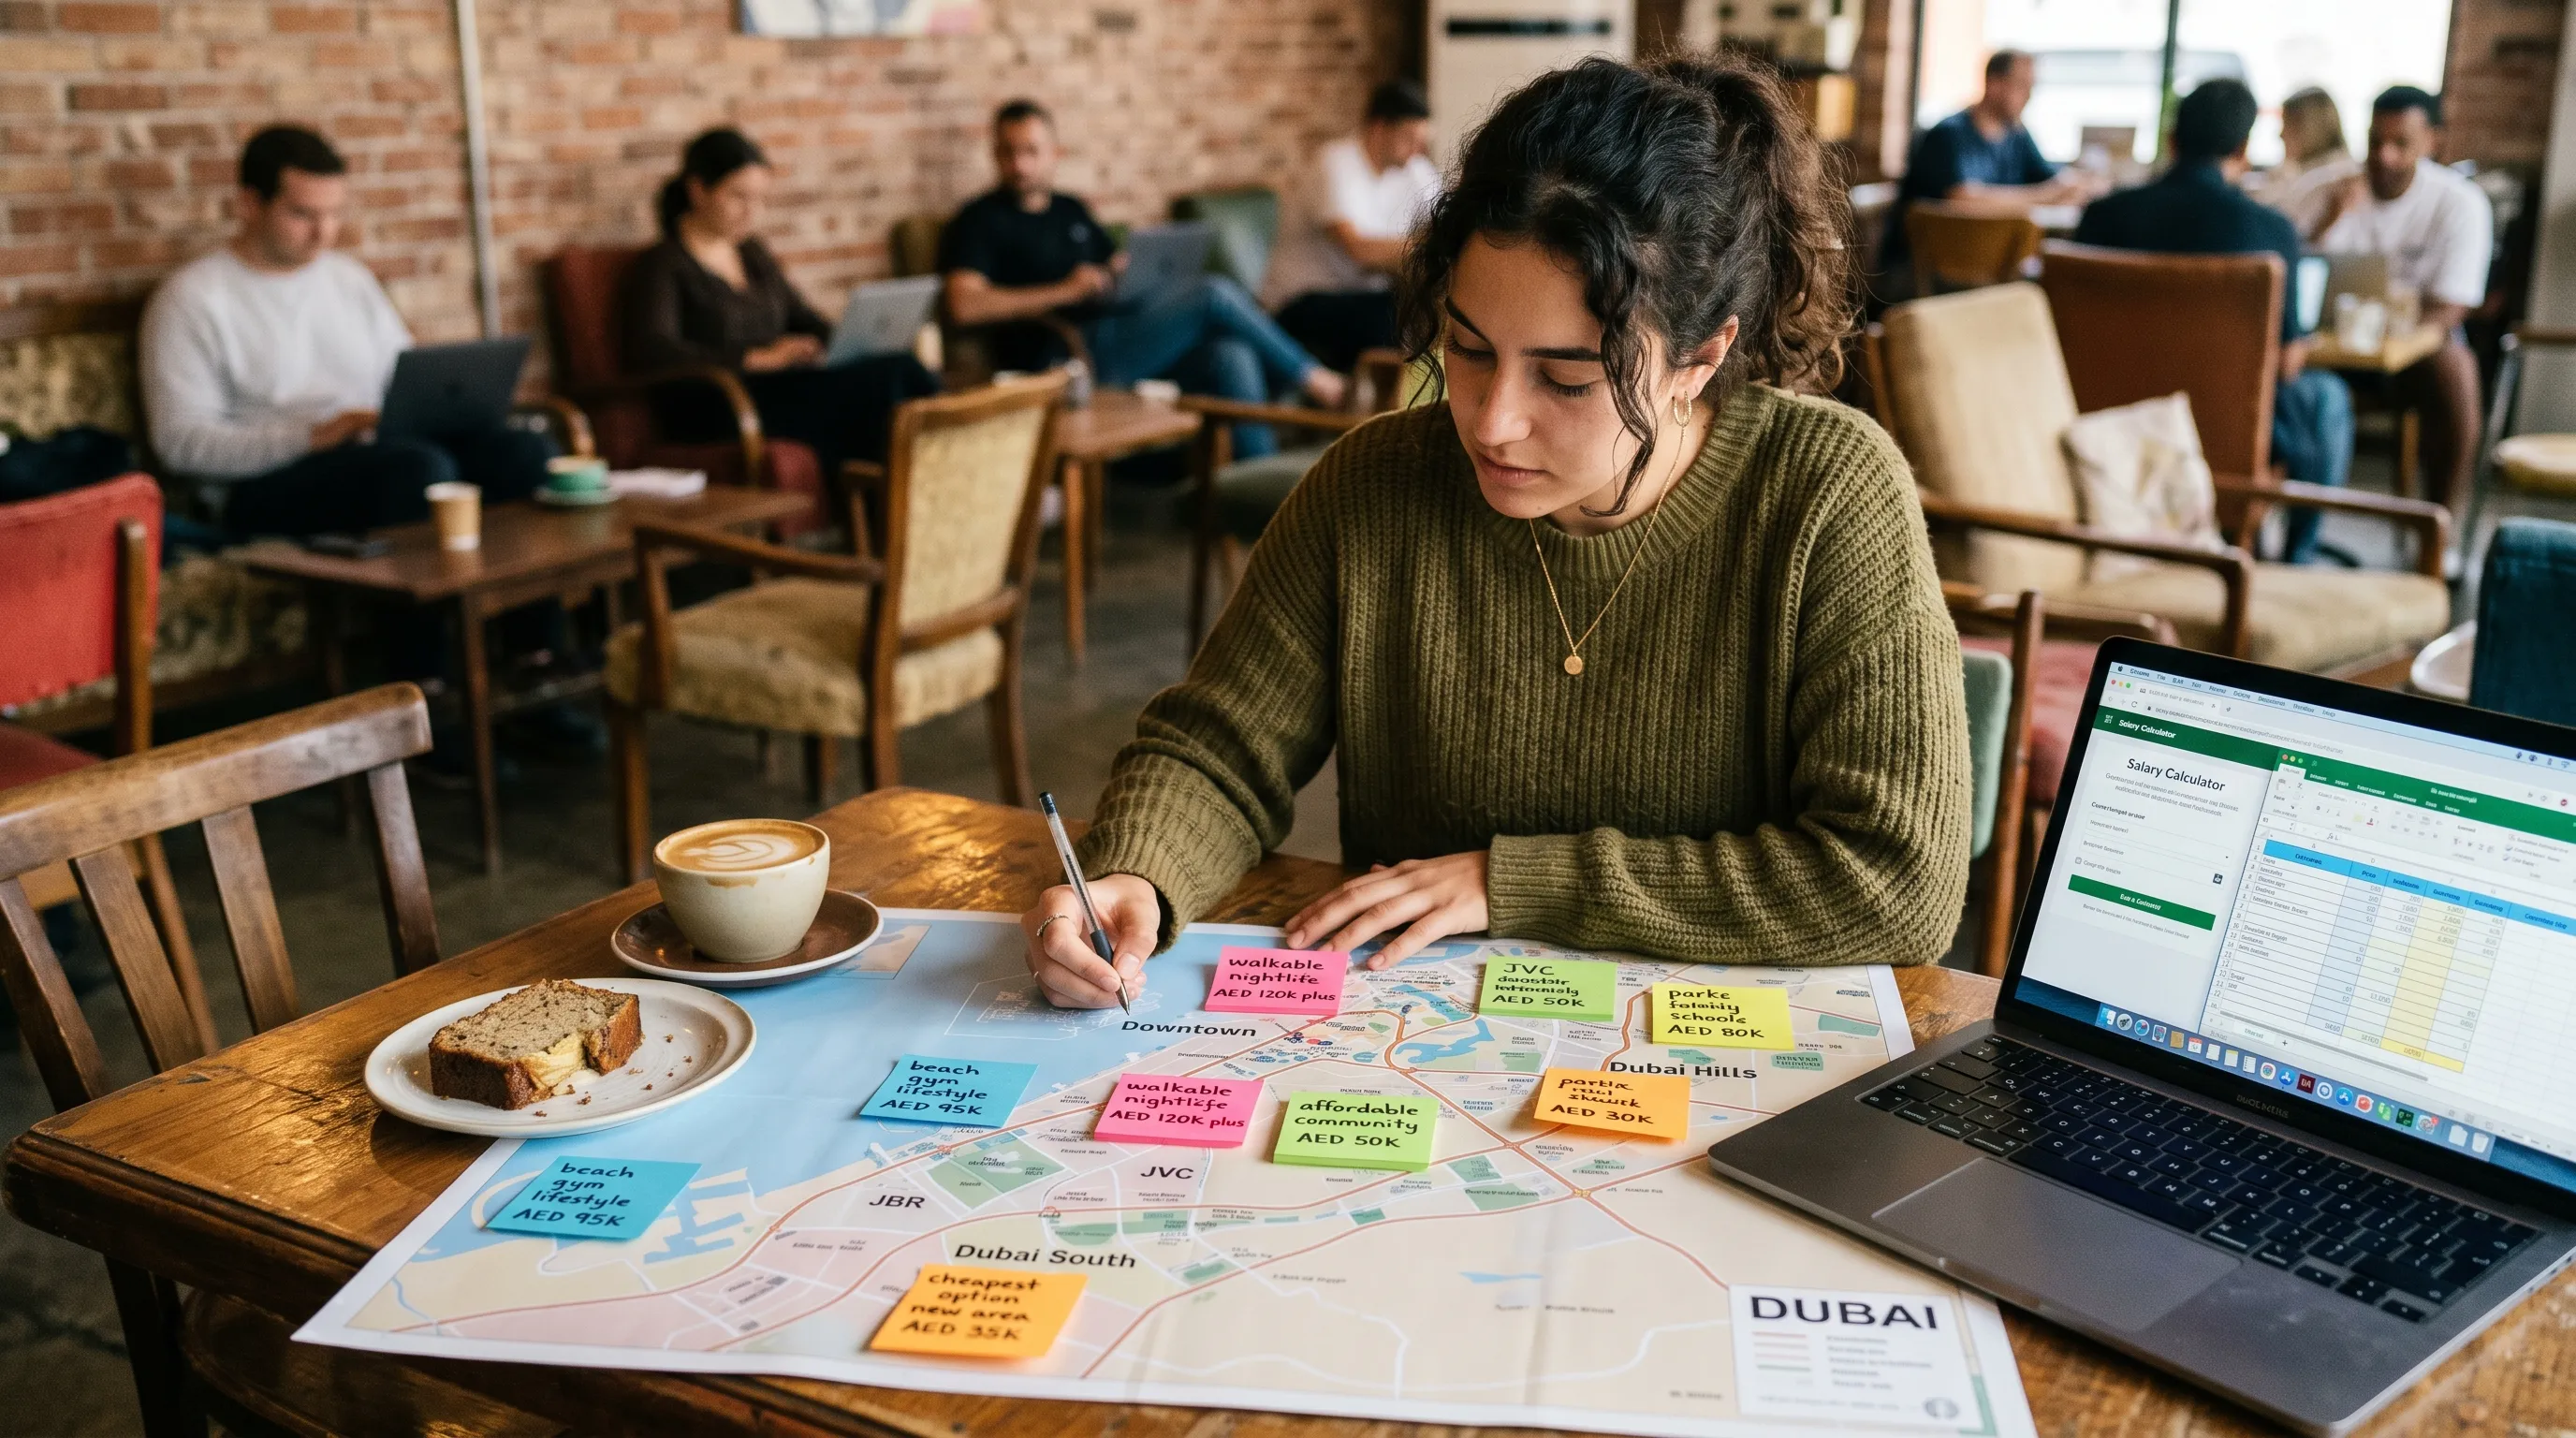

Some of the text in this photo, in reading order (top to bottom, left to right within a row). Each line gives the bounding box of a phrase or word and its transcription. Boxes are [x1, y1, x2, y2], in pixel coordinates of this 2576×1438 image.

[2127, 757, 2226, 792] Salary Calculator
[1228, 957, 1325, 971] walkable
[1504, 962, 1555, 976] JVC
[1213, 988, 1252, 999] AED
[1301, 990, 1336, 1003] plus
[1492, 995, 1534, 1005] AED
[1120, 1020, 1257, 1037] Downtown
[1667, 1024, 1764, 1038] AED 80K
[910, 1060, 980, 1076] beach
[1610, 1062, 1758, 1078] Dubai Hills
[906, 1076, 959, 1089] gym
[1127, 1082, 1233, 1096] walkable
[896, 1085, 988, 1103] lifestyle
[879, 1099, 983, 1115] AED 95K
[1299, 1099, 1419, 1116] affordable
[1550, 1104, 1654, 1124] AED 30K
[1109, 1110, 1246, 1129] AED 120K plus
[1294, 1117, 1418, 1135] community
[1296, 1132, 1401, 1148] AED 50K
[560, 1162, 634, 1179] beach
[1140, 1166, 1194, 1180] JVC
[550, 1180, 605, 1192] gym
[531, 1190, 632, 1211] lifestyle
[869, 1195, 926, 1209] JBR
[512, 1209, 626, 1227] AED 95K
[955, 1244, 1136, 1269] Dubai South
[929, 1273, 1042, 1291] cheapest
[938, 1290, 1019, 1304] option
[910, 1304, 1030, 1322] new area
[1749, 1296, 1938, 1329] DUBAI
[900, 1319, 1021, 1341] AED 35K
